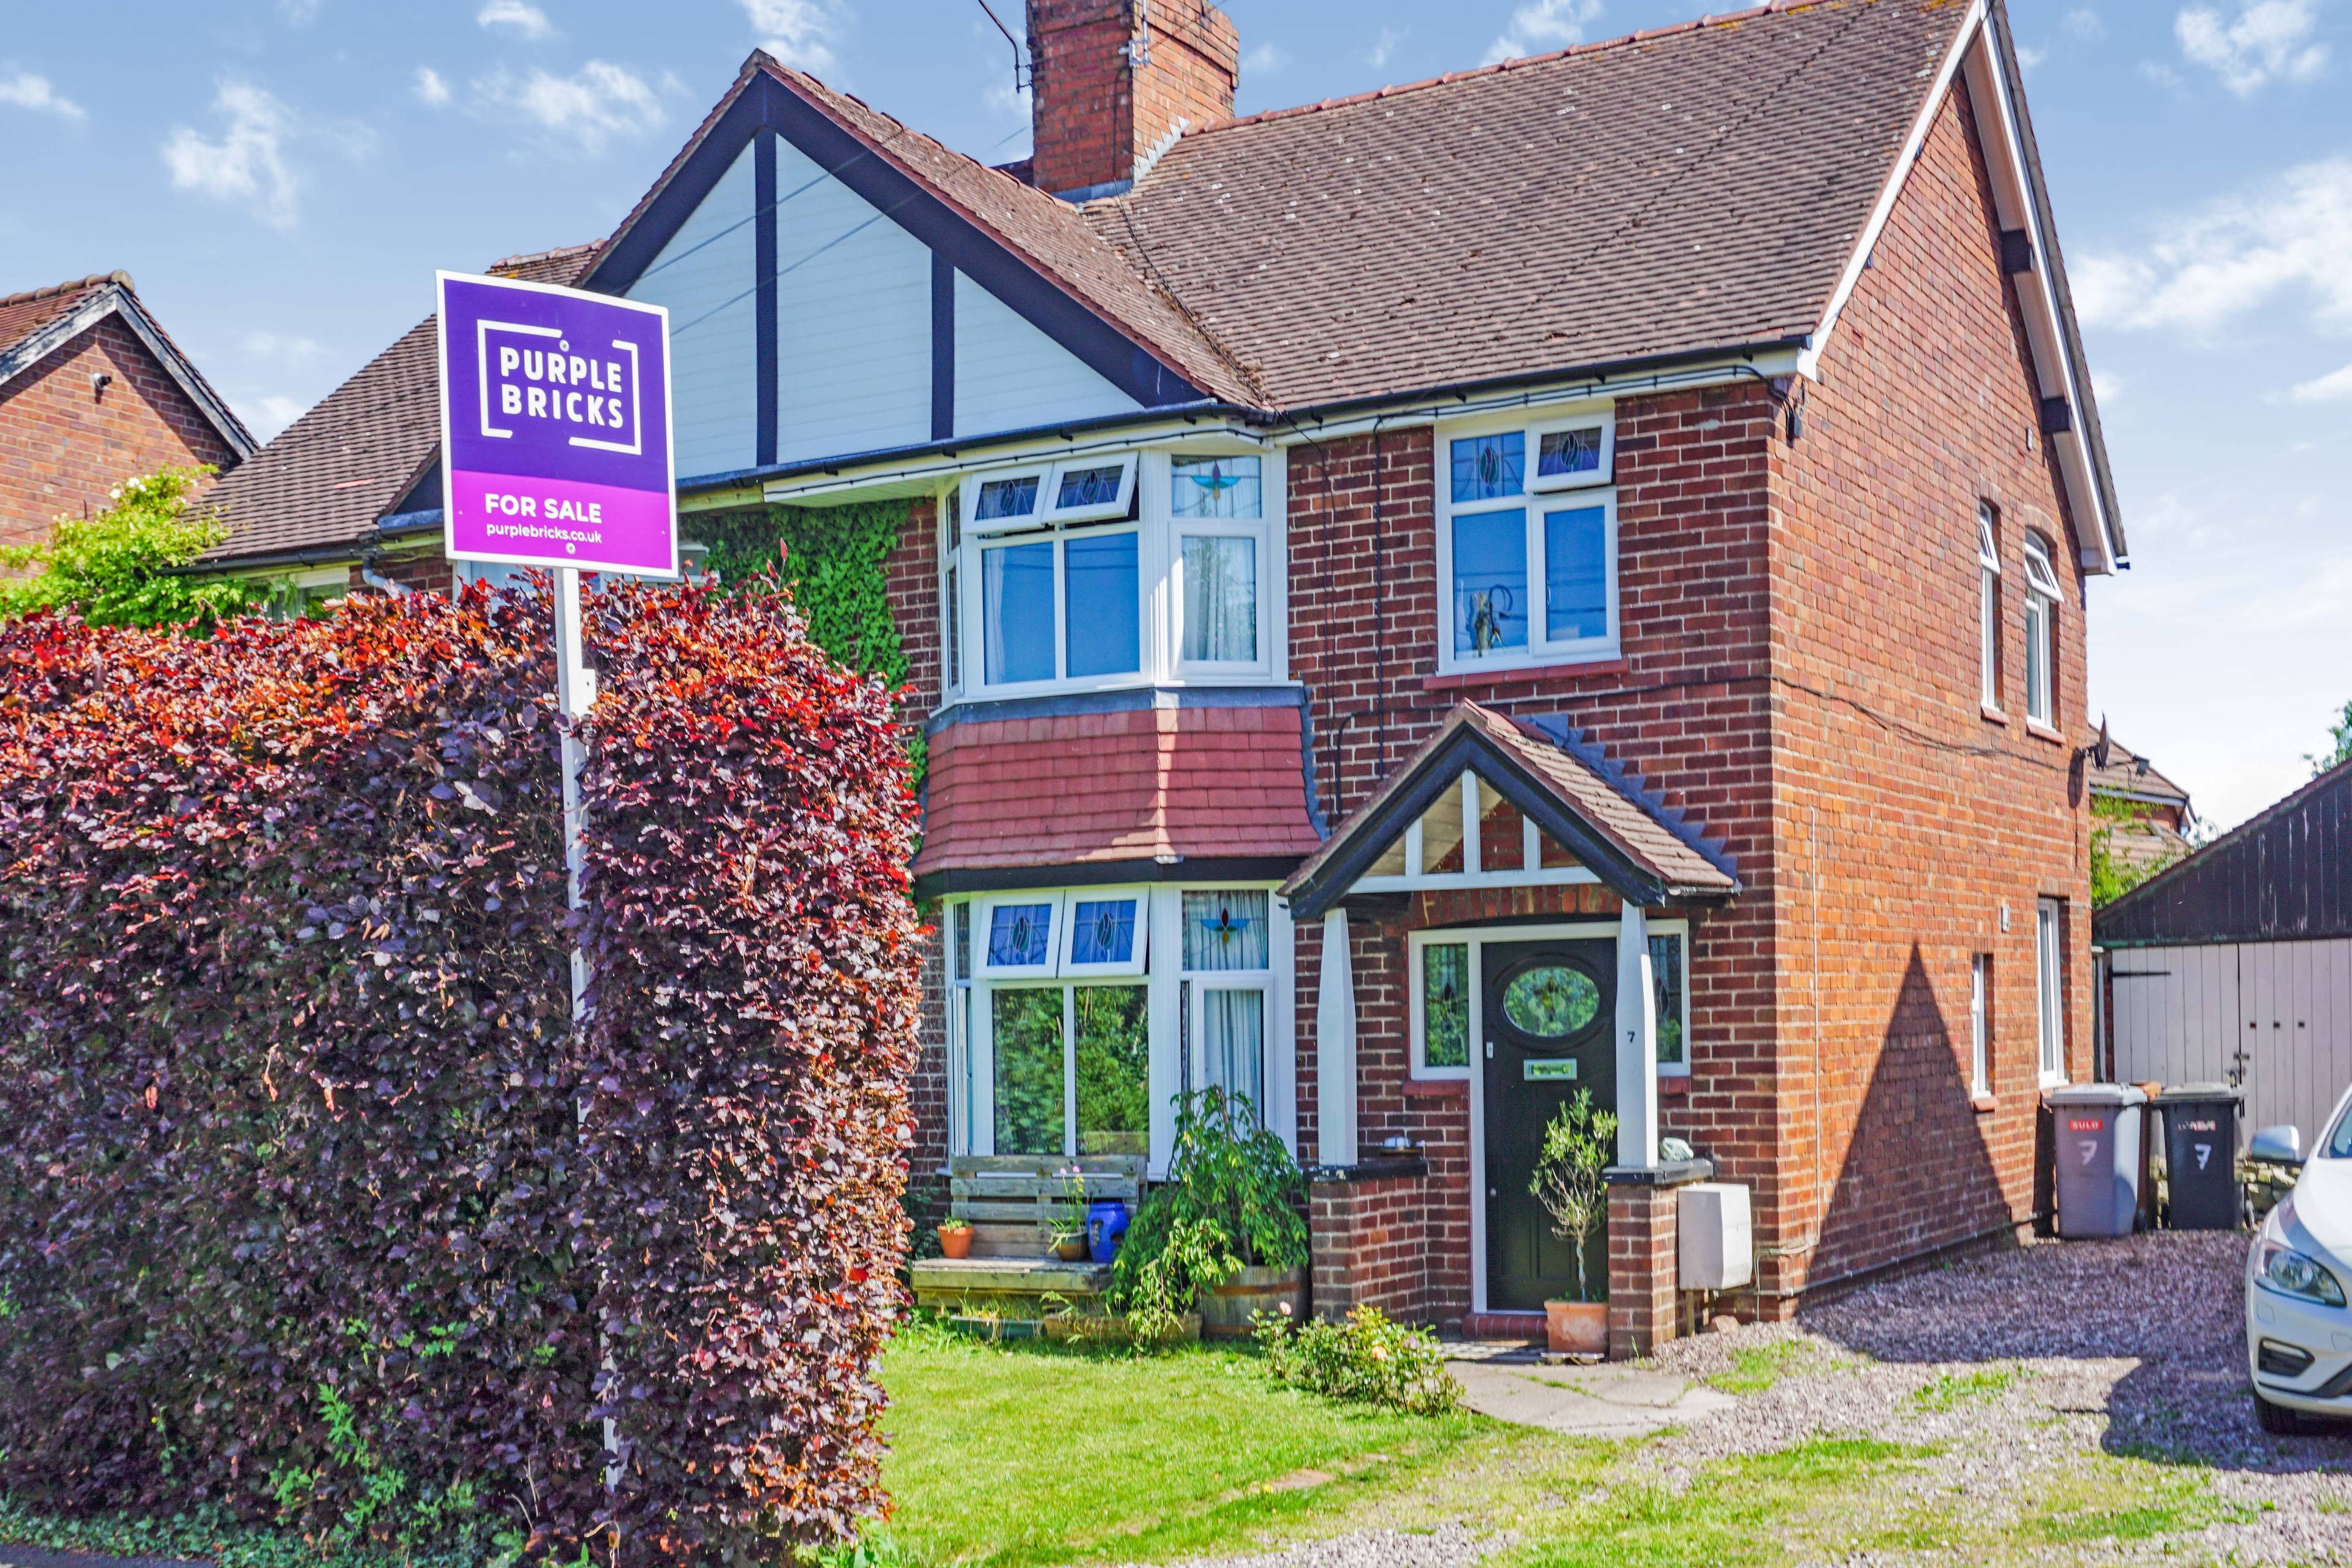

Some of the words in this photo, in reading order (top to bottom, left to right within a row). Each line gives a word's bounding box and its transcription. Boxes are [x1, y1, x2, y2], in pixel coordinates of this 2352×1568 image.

[500, 347, 622, 393] PURPLE
[501, 383, 624, 429] BRICKS
[485, 493, 537, 518] FOR
[544, 498, 602, 524] SALE
[486, 523, 603, 543] purplebricks.co.uk
[1627, 1031, 1635, 1044] 7
[2078, 1140, 2097, 1165] 7
[2195, 1144, 2212, 1170] 7
